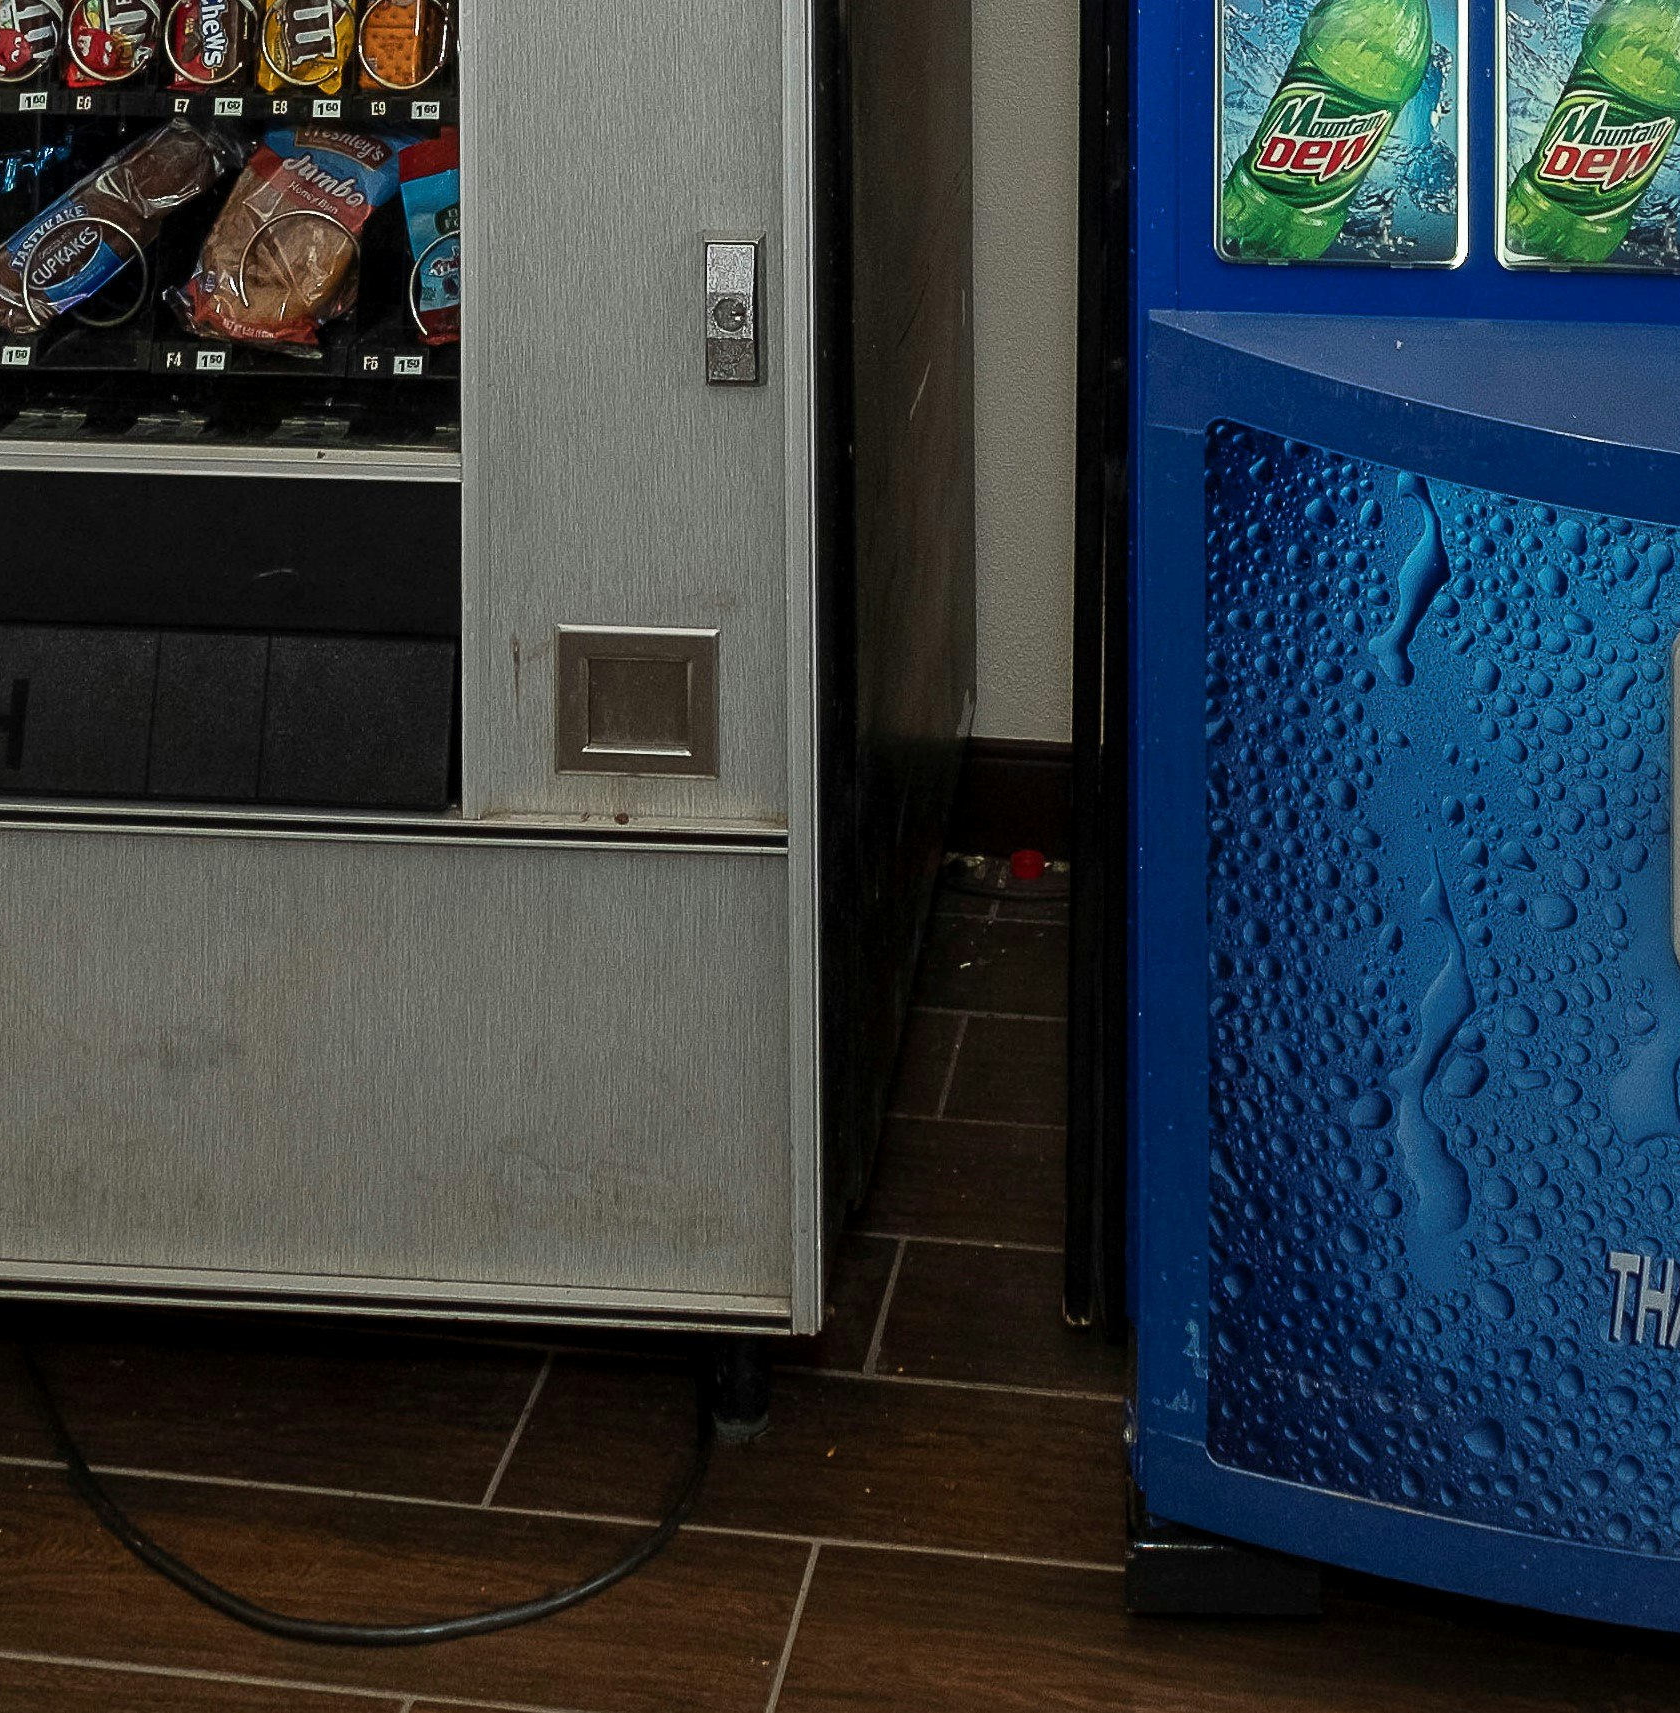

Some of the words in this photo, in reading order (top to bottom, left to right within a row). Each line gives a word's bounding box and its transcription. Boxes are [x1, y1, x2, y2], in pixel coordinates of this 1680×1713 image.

[1277, 94, 1392, 140] Mountain
[1559, 102, 1676, 148] Mountain
[282, 154, 365, 207] Jumbo
[1260, 133, 1371, 181] DEW
[1542, 143, 1659, 190] DEW
[288, 180, 315, 203] Honey
[317, 196, 340, 215] Bun
[31, 226, 98, 285] CUPKAKES
